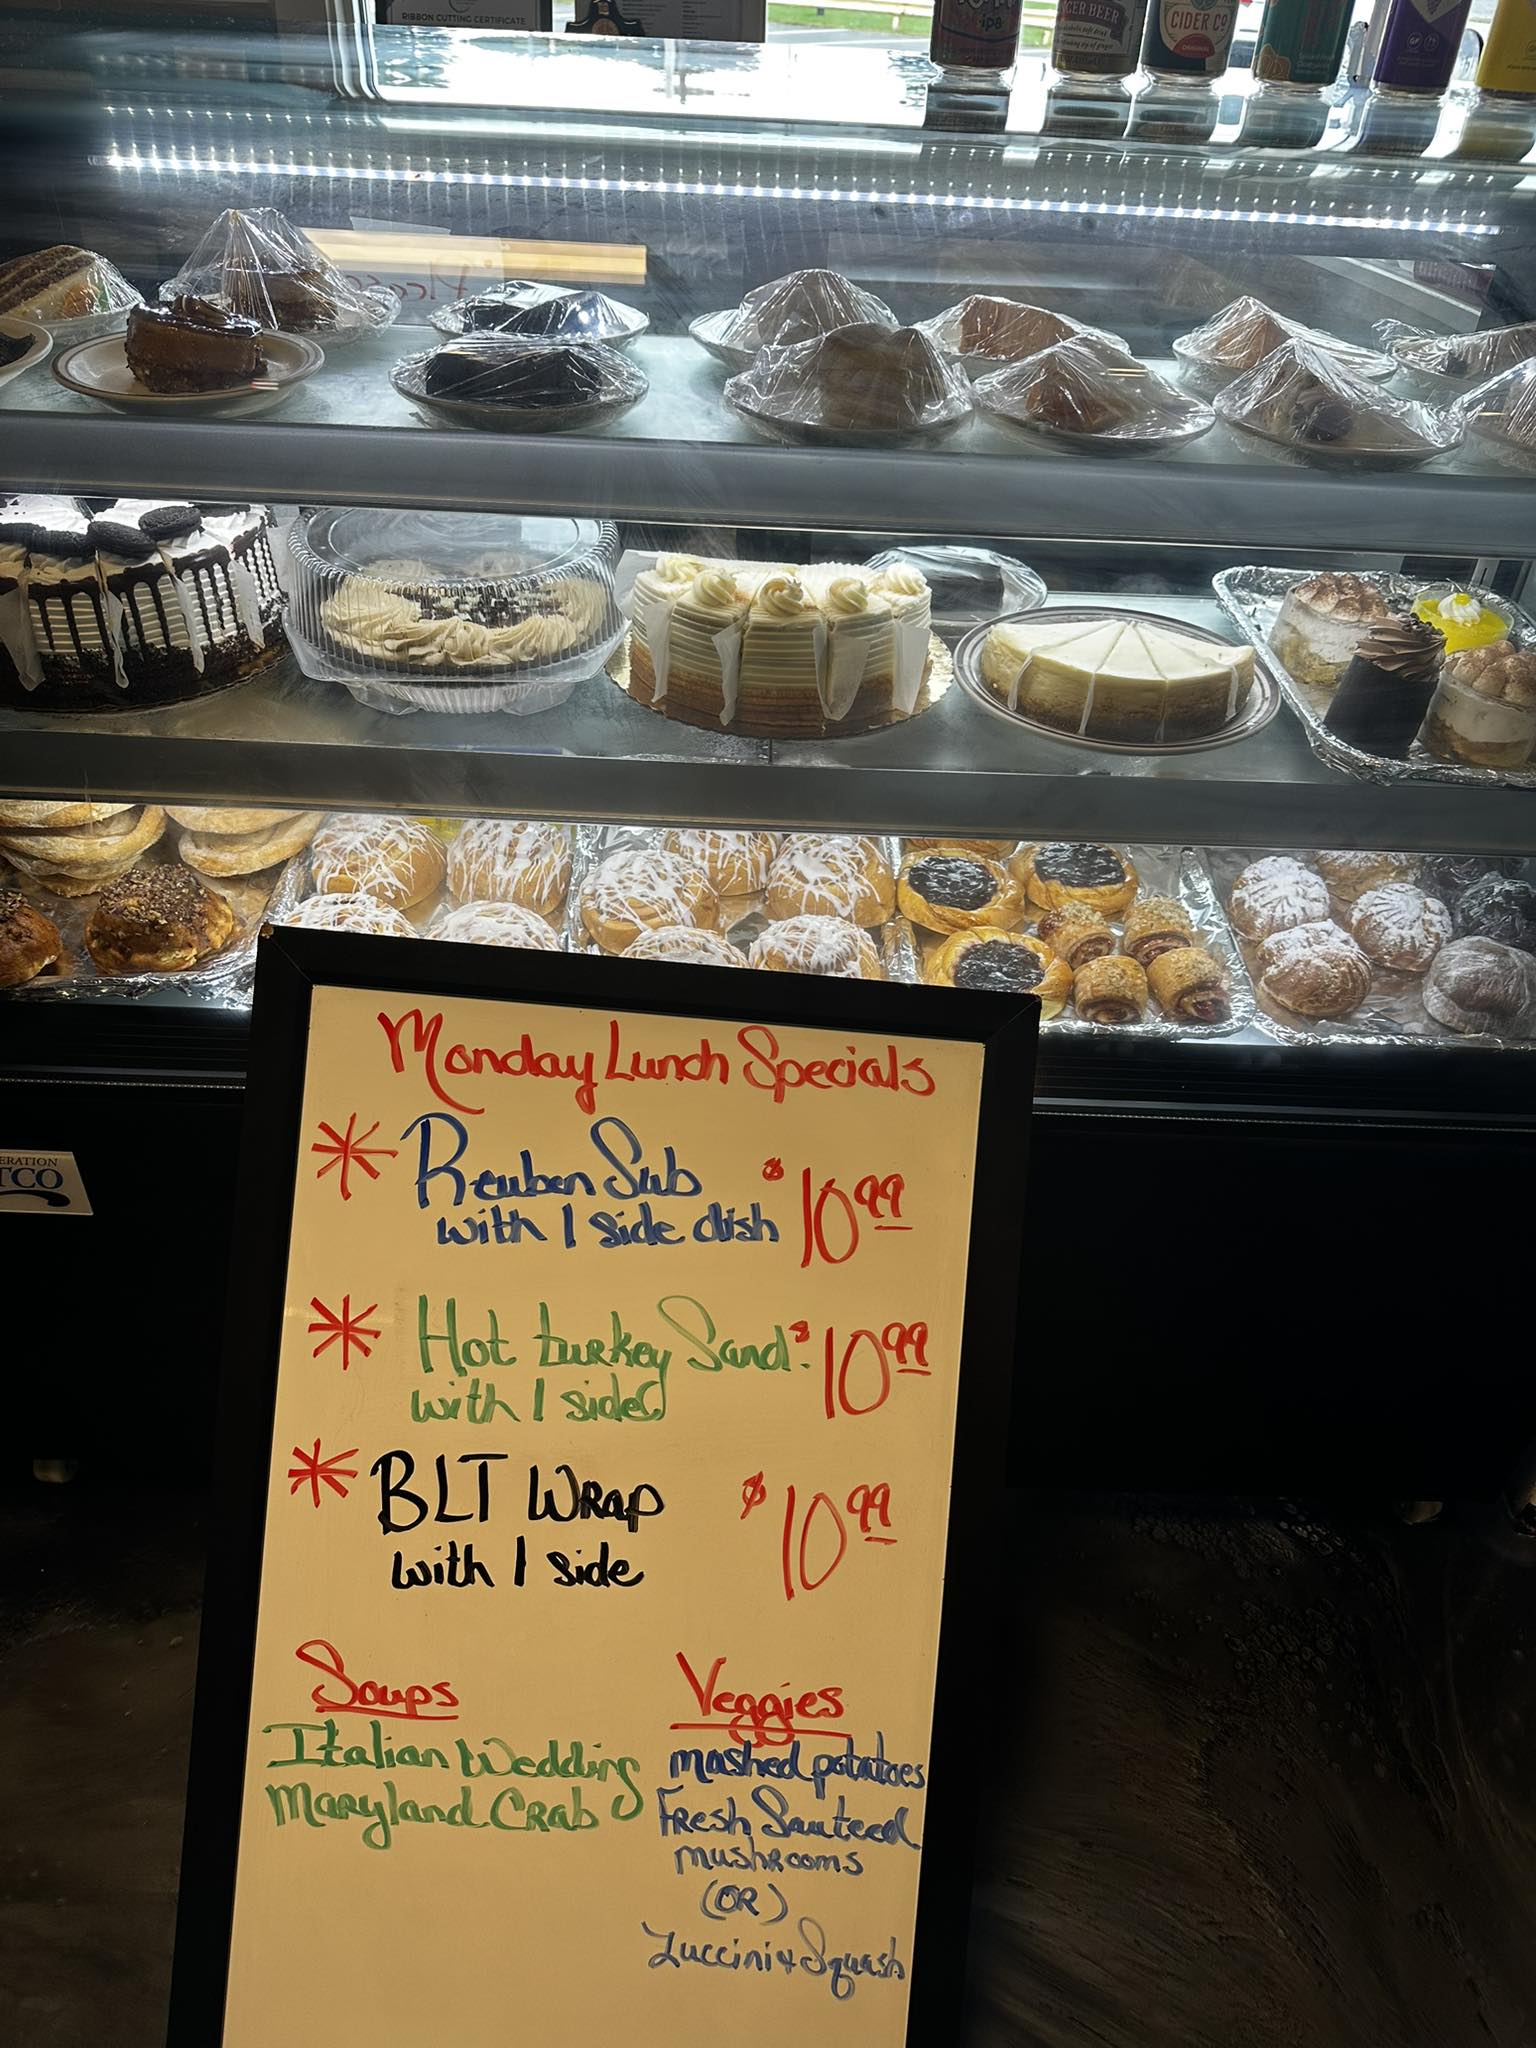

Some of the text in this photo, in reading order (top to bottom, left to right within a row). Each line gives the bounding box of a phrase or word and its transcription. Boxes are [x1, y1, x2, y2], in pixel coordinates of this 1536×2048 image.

[402, 12, 527, 26] RIBBON CUTTING CERTIFICATE
[1088, 3, 1120, 25] BEER
[1170, 11, 1209, 31] CIDER
[378, 1009, 936, 1115] Monday Lunch Specials
[0, 1156, 59, 1167] ERATION
[400, 1112, 595, 1209] Reuben
[590, 1117, 702, 1200] Sub
[437, 1204, 547, 1246] with
[590, 1202, 686, 1248] side
[693, 1202, 782, 1244] dish
[419, 1294, 518, 1377] Hot
[411, 1377, 520, 1424] with
[371, 1450, 508, 1534] BLT
[391, 1540, 495, 1589] with
[546, 1540, 645, 1589] side
[295, 1639, 459, 1720] Soups
[670, 1651, 844, 1749] Veggies
[262, 1718, 644, 1820] Italian Wedding
[670, 1731, 926, 1800] mashed potatoes
[750, 1784, 922, 1850] Sauteed
[700, 1879, 789, 1926] (OR)
[799, 1916, 906, 2000] Squash
